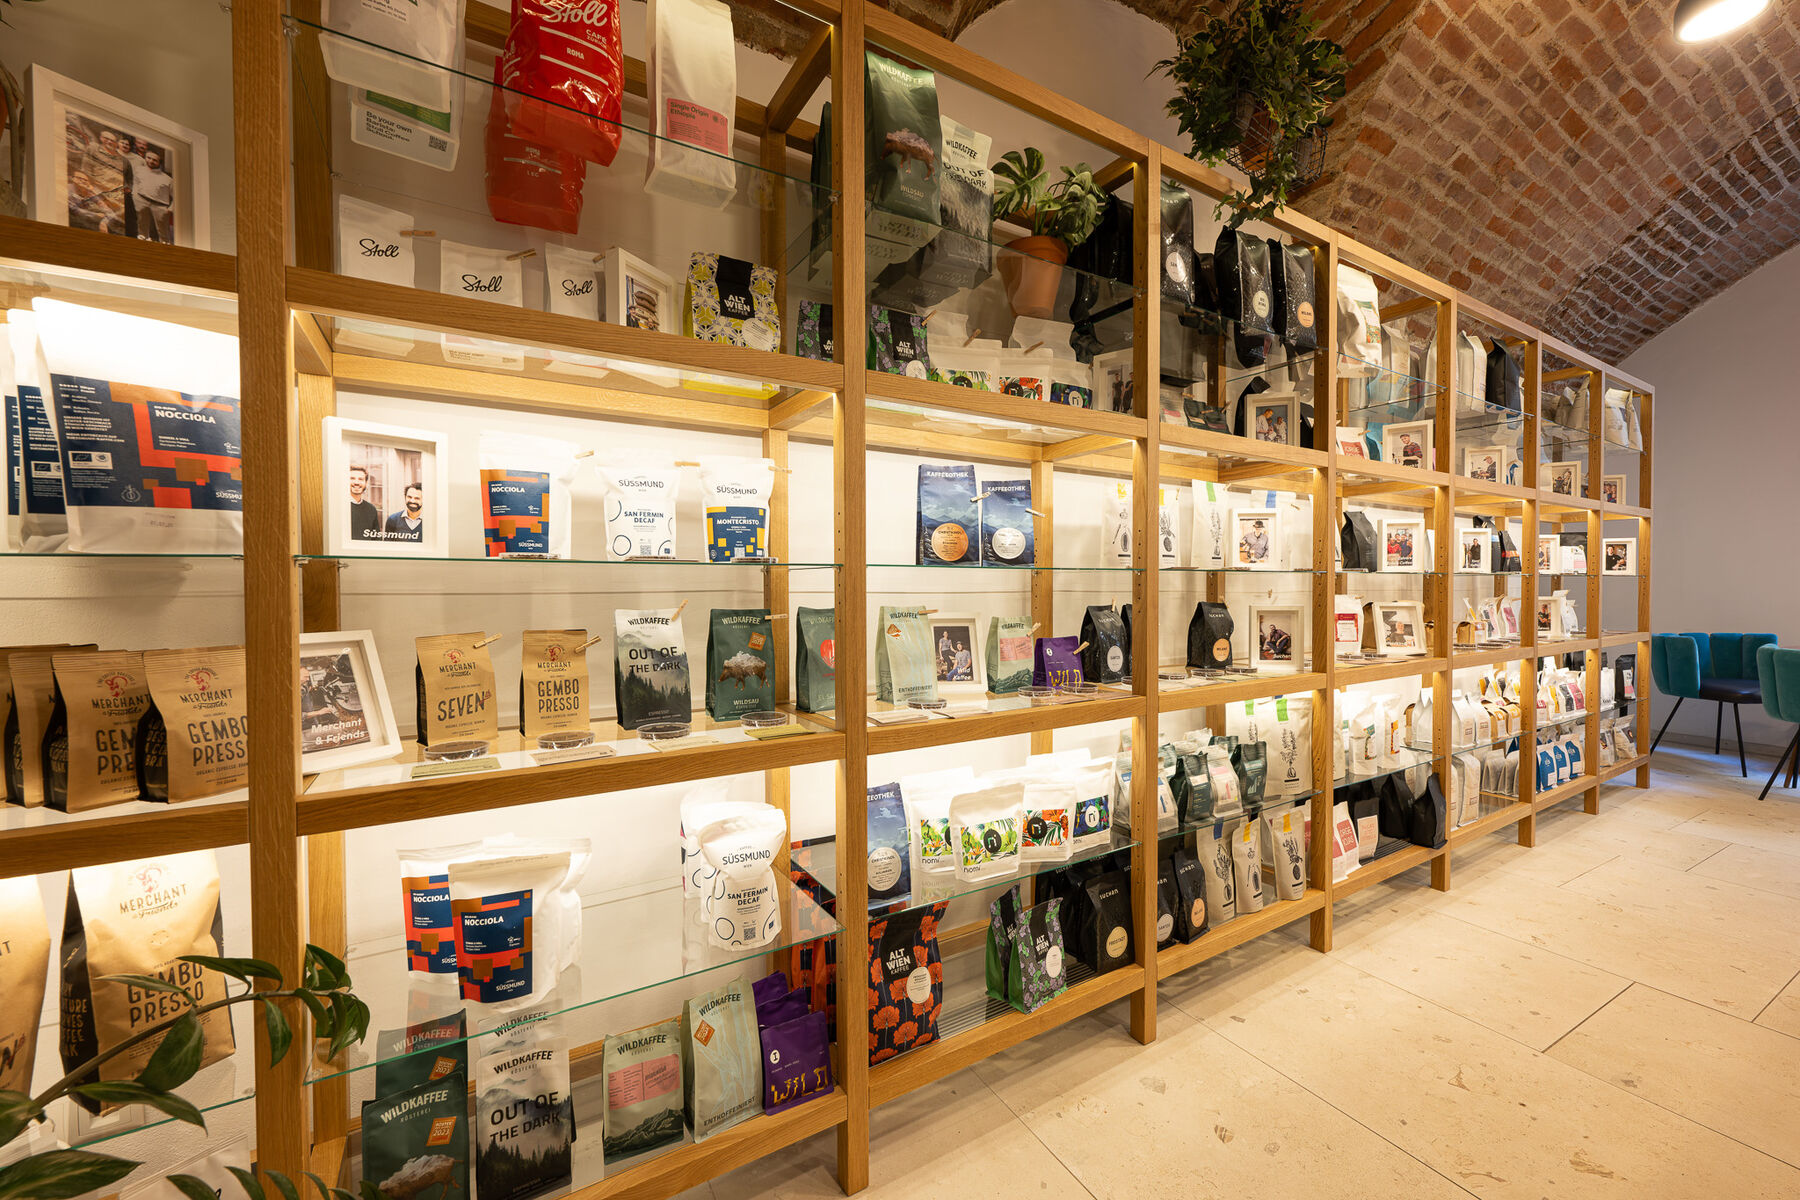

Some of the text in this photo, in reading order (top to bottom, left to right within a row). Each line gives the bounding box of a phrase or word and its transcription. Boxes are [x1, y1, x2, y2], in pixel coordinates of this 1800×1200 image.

[566, 48, 585, 60] ROMA
[670, 102, 690, 112] Single
[378, 115, 396, 128] your
[359, 238, 400, 259] Stoll
[461, 274, 503, 294] Stoll
[562, 279, 594, 298] Stoll
[728, 294, 746, 305] ALT
[724, 300, 751, 314] WIEN
[896, 346, 914, 355] WIEN
[898, 340, 910, 348] ALT
[154, 410, 216, 424] NOCCIOLA
[492, 486, 525, 494] NOCCIOLA
[618, 478, 664, 489] SÜSSMUND
[716, 486, 758, 496] SÜSSMUND
[716, 518, 760, 526] MONTECRISTO
[362, 529, 420, 541] Süssmund
[628, 617, 670, 626] WILDKAFFEE
[721, 616, 762, 625] WILDKAFFEE
[628, 646, 678, 660] OUT OF
[438, 662, 476, 673] MERCHANT
[628, 662, 680, 673] THE DARK
[538, 678, 580, 698] GEMBO
[91, 694, 150, 710] MERCHANT
[179, 688, 233, 703] MERCHANT
[438, 690, 485, 722] SEVEN
[538, 696, 580, 713] PRESSO
[188, 715, 248, 744] GEMBO
[312, 718, 363, 734] Merchant
[315, 730, 366, 746] & Friends
[192, 740, 248, 767] PRESS
[722, 850, 771, 866] SÜSSMUND
[119, 883, 188, 915] MERCHANT
[413, 894, 450, 903] NOCCIOLA
[743, 886, 768, 898] FERMIN
[738, 896, 760, 906] DECAF
[464, 916, 504, 926] NOCCIOLA
[1036, 934, 1044, 945] ALT
[1036, 940, 1050, 952] WIEN
[890, 948, 906, 960] ALT
[886, 956, 911, 970] WIEN
[890, 964, 910, 976] KAFFEE
[496, 980, 526, 992] SÜSSMUND
[130, 981, 204, 1028] PRESSO
[698, 993, 742, 1016] WILDKAFFEE
[392, 1028, 453, 1052] WILDKAFFEE
[616, 1034, 668, 1055] WILDKAFFEE
[494, 1050, 554, 1075] WILDKAFFEE
[380, 1090, 448, 1124] WILDKAFFEE
[490, 1091, 559, 1126] OUT OF
[703, 1096, 756, 1127] ENTKOFFEINIERT
[490, 1110, 561, 1144] THE DARK
